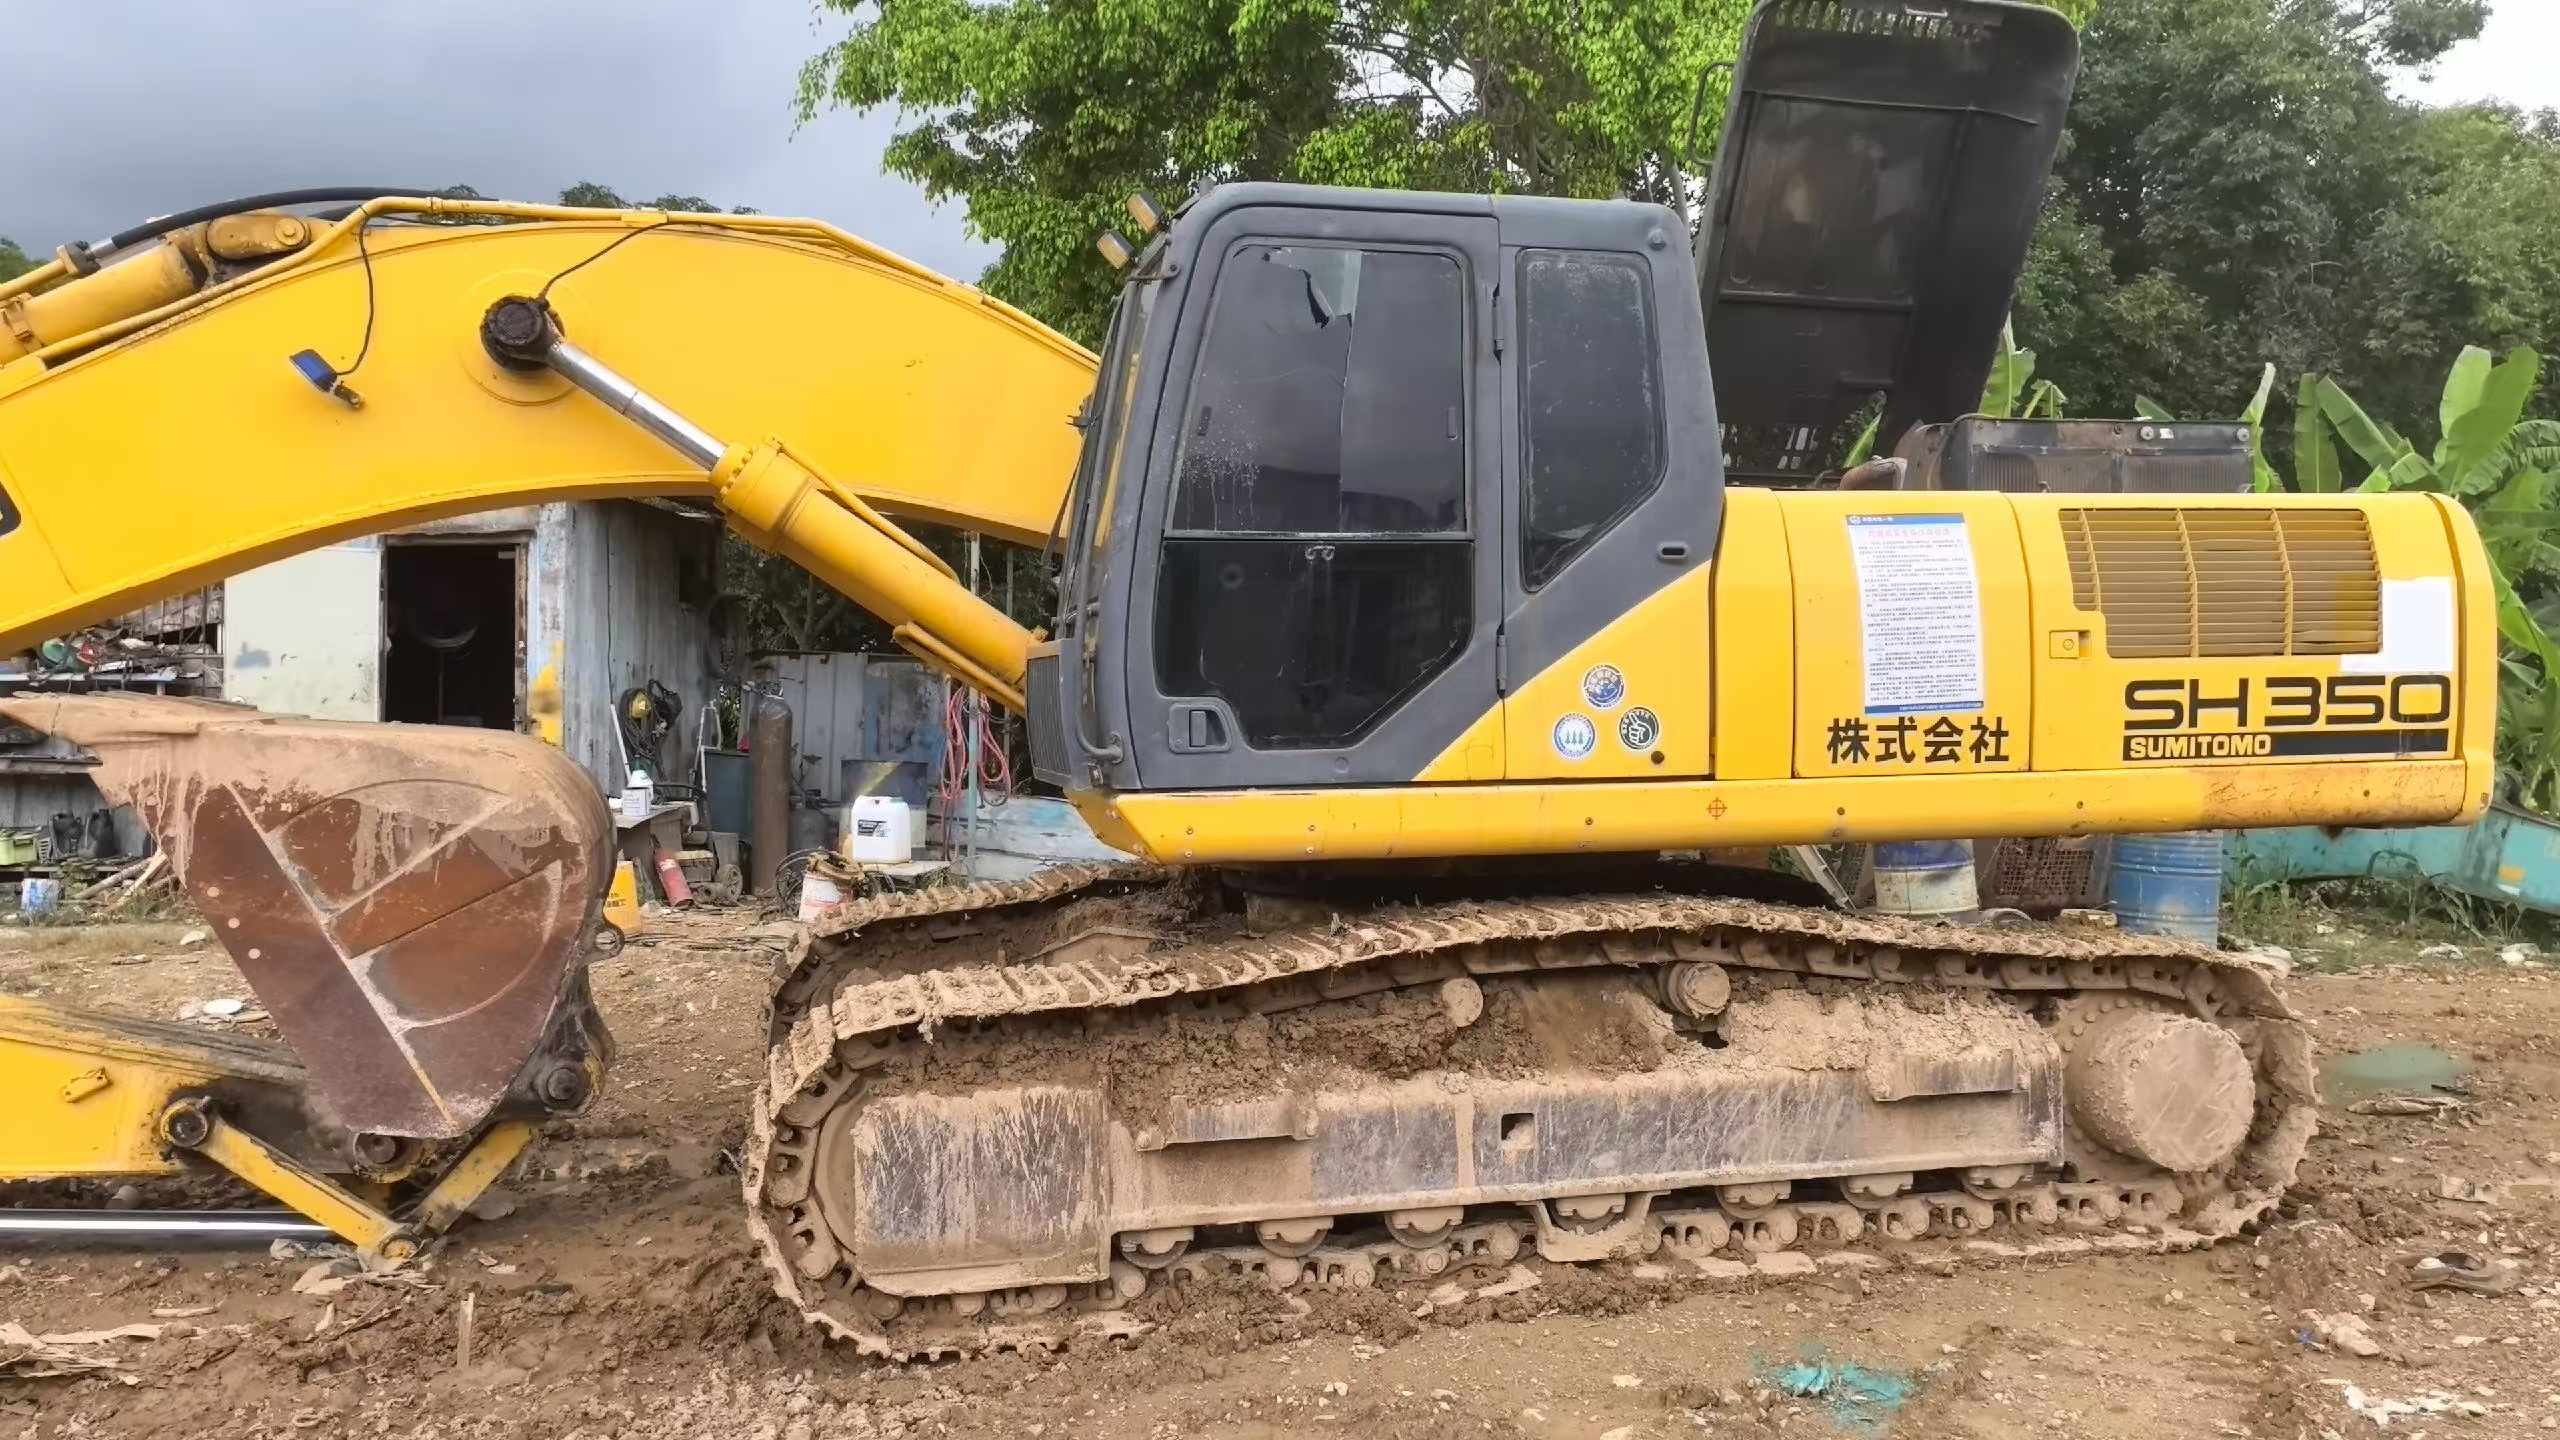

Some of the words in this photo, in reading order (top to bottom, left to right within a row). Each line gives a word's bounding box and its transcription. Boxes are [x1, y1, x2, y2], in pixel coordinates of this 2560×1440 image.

[1826, 715, 2010, 764] 株式会社
[2129, 734, 2272, 759] SUMITOMO
